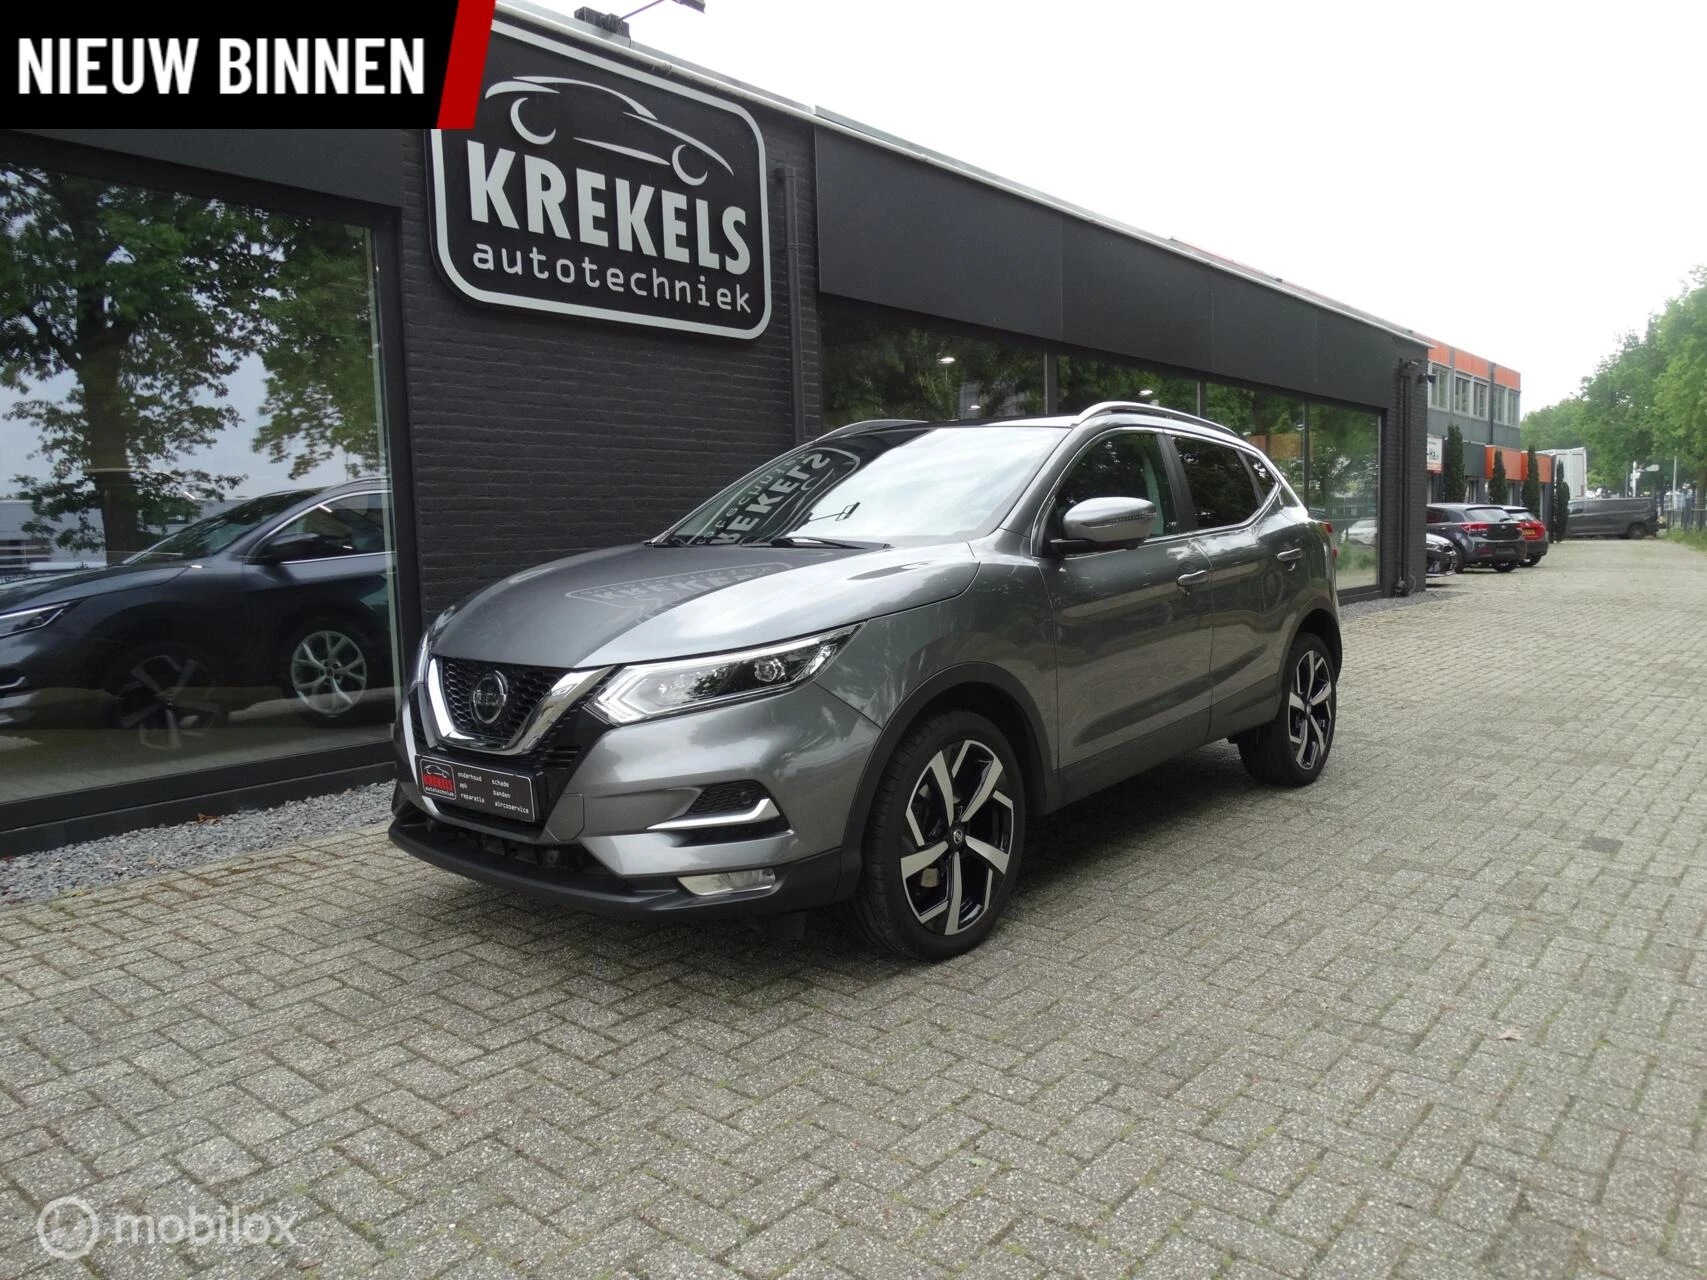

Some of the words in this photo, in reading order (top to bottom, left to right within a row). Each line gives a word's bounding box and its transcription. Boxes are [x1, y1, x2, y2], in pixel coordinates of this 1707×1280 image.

[467, 140, 751, 275] KREKELS
[473, 242, 751, 314] autotechniek
[457, 772, 482, 782] onderhoud
[491, 779, 509, 788] schade
[460, 793, 485, 803] reparatie
[492, 790, 511, 799] banden
[494, 801, 529, 814] aircoservice
